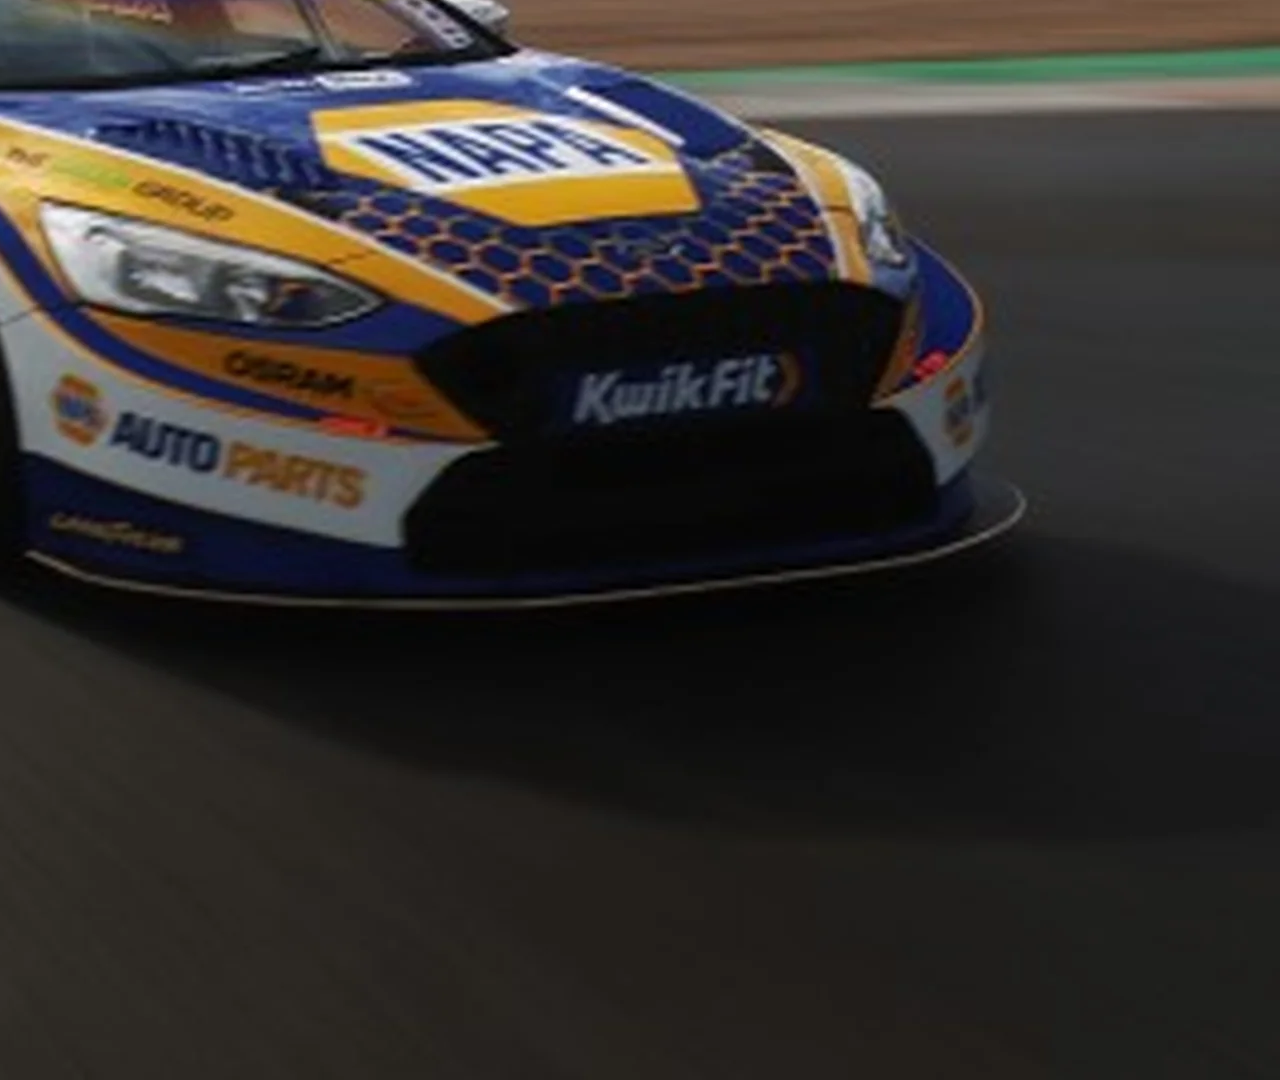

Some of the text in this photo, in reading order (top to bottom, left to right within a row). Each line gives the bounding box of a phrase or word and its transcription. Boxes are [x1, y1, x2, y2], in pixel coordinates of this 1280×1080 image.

[356, 120, 650, 184] NAPA
[221, 350, 356, 400] OSRAM
[106, 410, 222, 474] AUTO
[221, 438, 370, 512] PARTS
